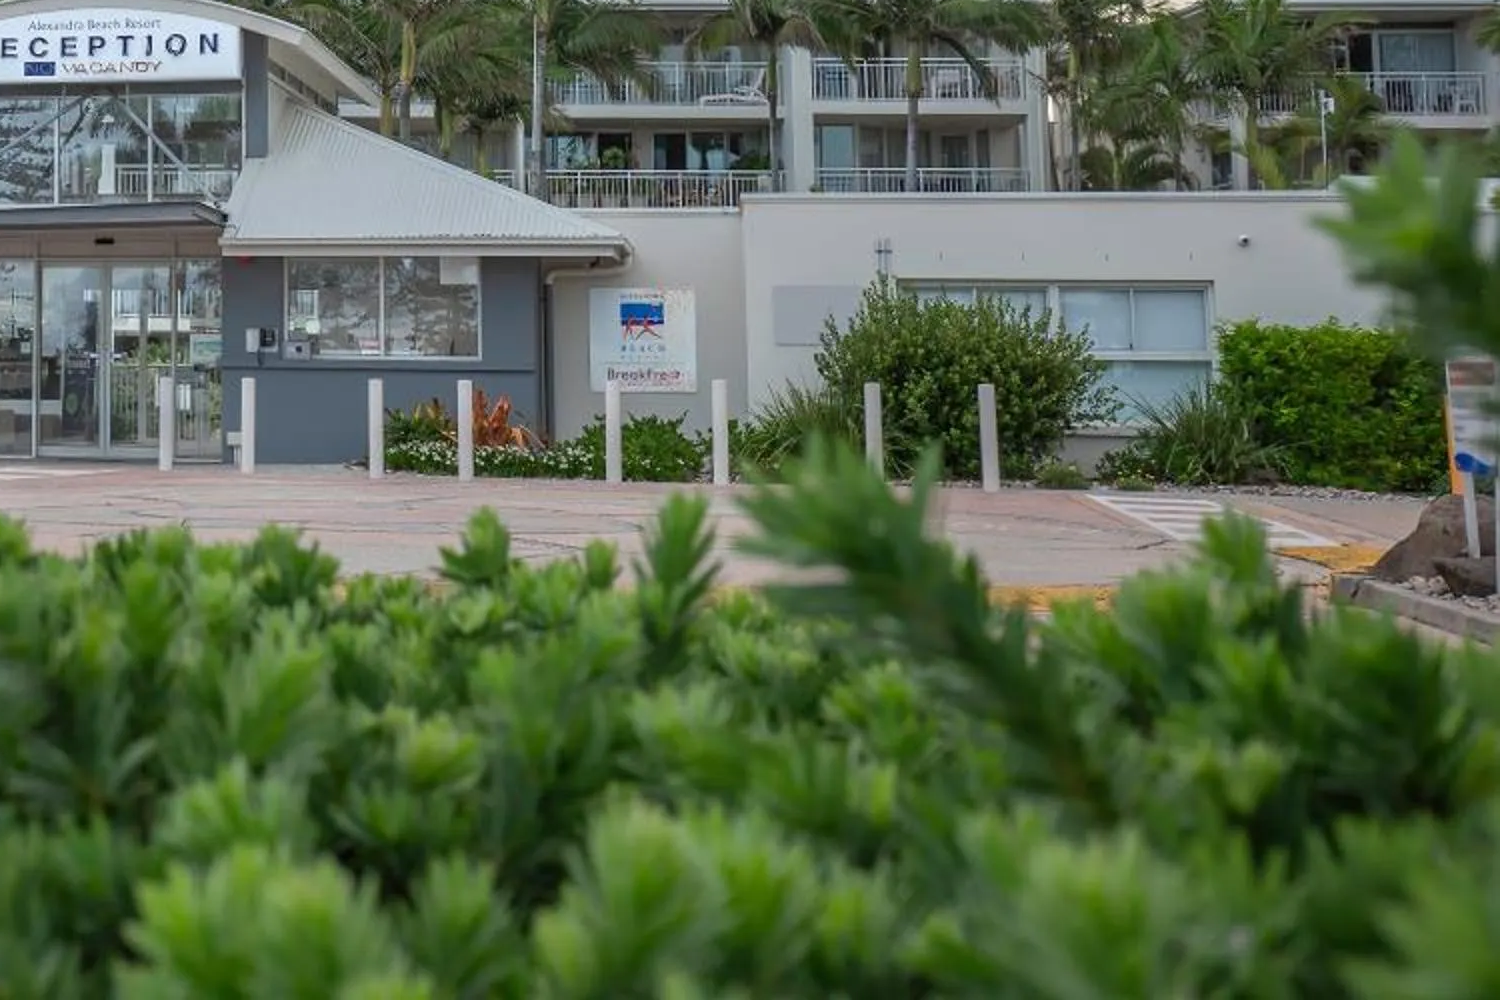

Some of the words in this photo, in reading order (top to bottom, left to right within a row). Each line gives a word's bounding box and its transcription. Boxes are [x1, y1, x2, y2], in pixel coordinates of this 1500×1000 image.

[27, 19, 85, 31] Alexandra
[87, 18, 122, 30] Beach
[124, 17, 162, 30] Resort
